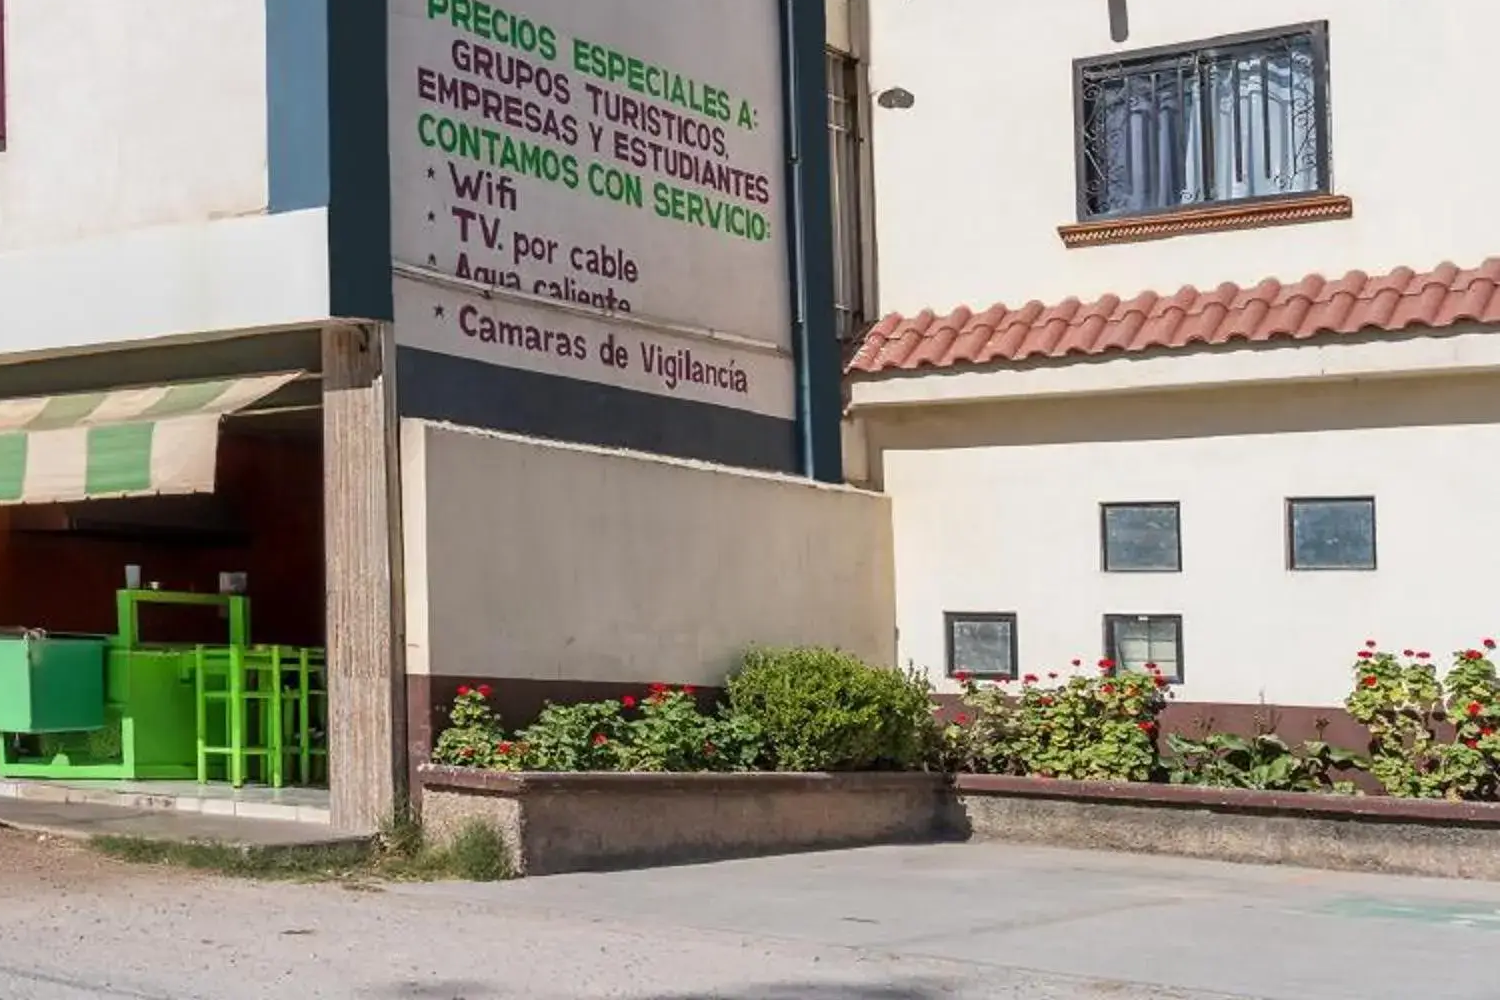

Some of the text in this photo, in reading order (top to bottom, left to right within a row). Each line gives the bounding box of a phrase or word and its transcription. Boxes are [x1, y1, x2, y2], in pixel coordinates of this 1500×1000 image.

[451, 39, 571, 105] GRUPOS
[572, 37, 731, 122] ESPECIALES
[737, 100, 759, 130] A:
[417, 66, 770, 204] EMPRESAS Y ESTUDIANTES
[417, 113, 772, 241] CONTAMOS CON SERVICIO:
[447, 161, 517, 211] Wifi
[451, 206, 639, 283] TV. por cable
[458, 304, 587, 361] Camaras
[600, 333, 629, 369] de
